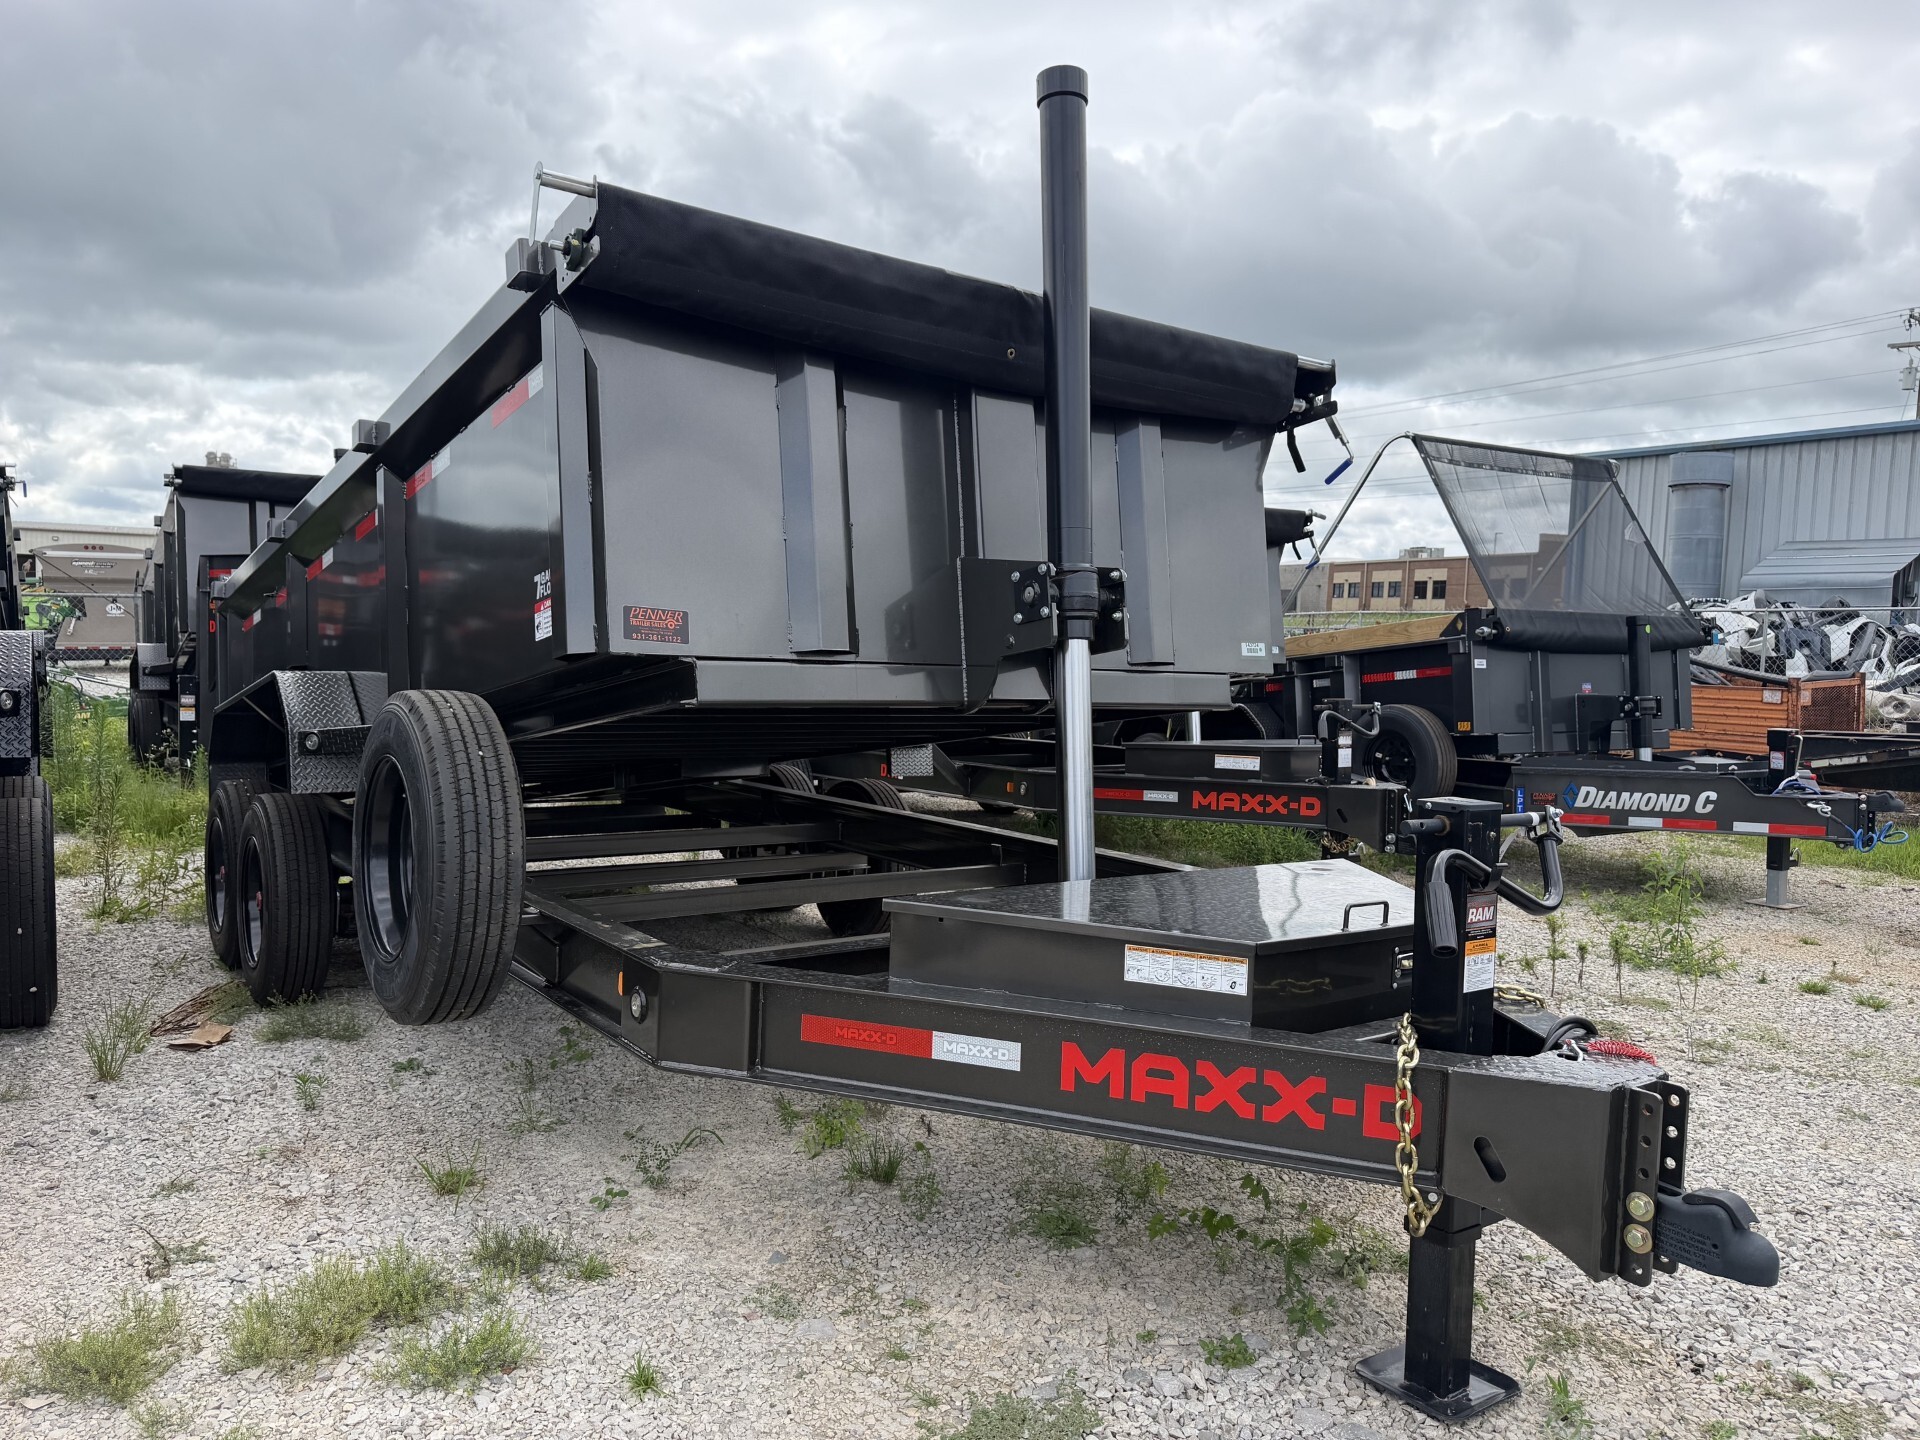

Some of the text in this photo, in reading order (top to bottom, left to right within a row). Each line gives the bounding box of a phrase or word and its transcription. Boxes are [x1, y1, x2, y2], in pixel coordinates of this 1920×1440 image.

[534, 573, 541, 600] 7
[630, 607, 683, 623] PENNER
[632, 632, 682, 643] 931-361-1122
[1147, 792, 1174, 800] MAXX-D
[1192, 790, 1321, 817] MAXX-D
[1573, 785, 1718, 814] DIAMOND C
[1467, 905, 1495, 923] RAM
[834, 1026, 898, 1046] MAXX-D
[943, 1040, 1010, 1061] MAXX-D
[1060, 1041, 1422, 1142] MAXX-D
